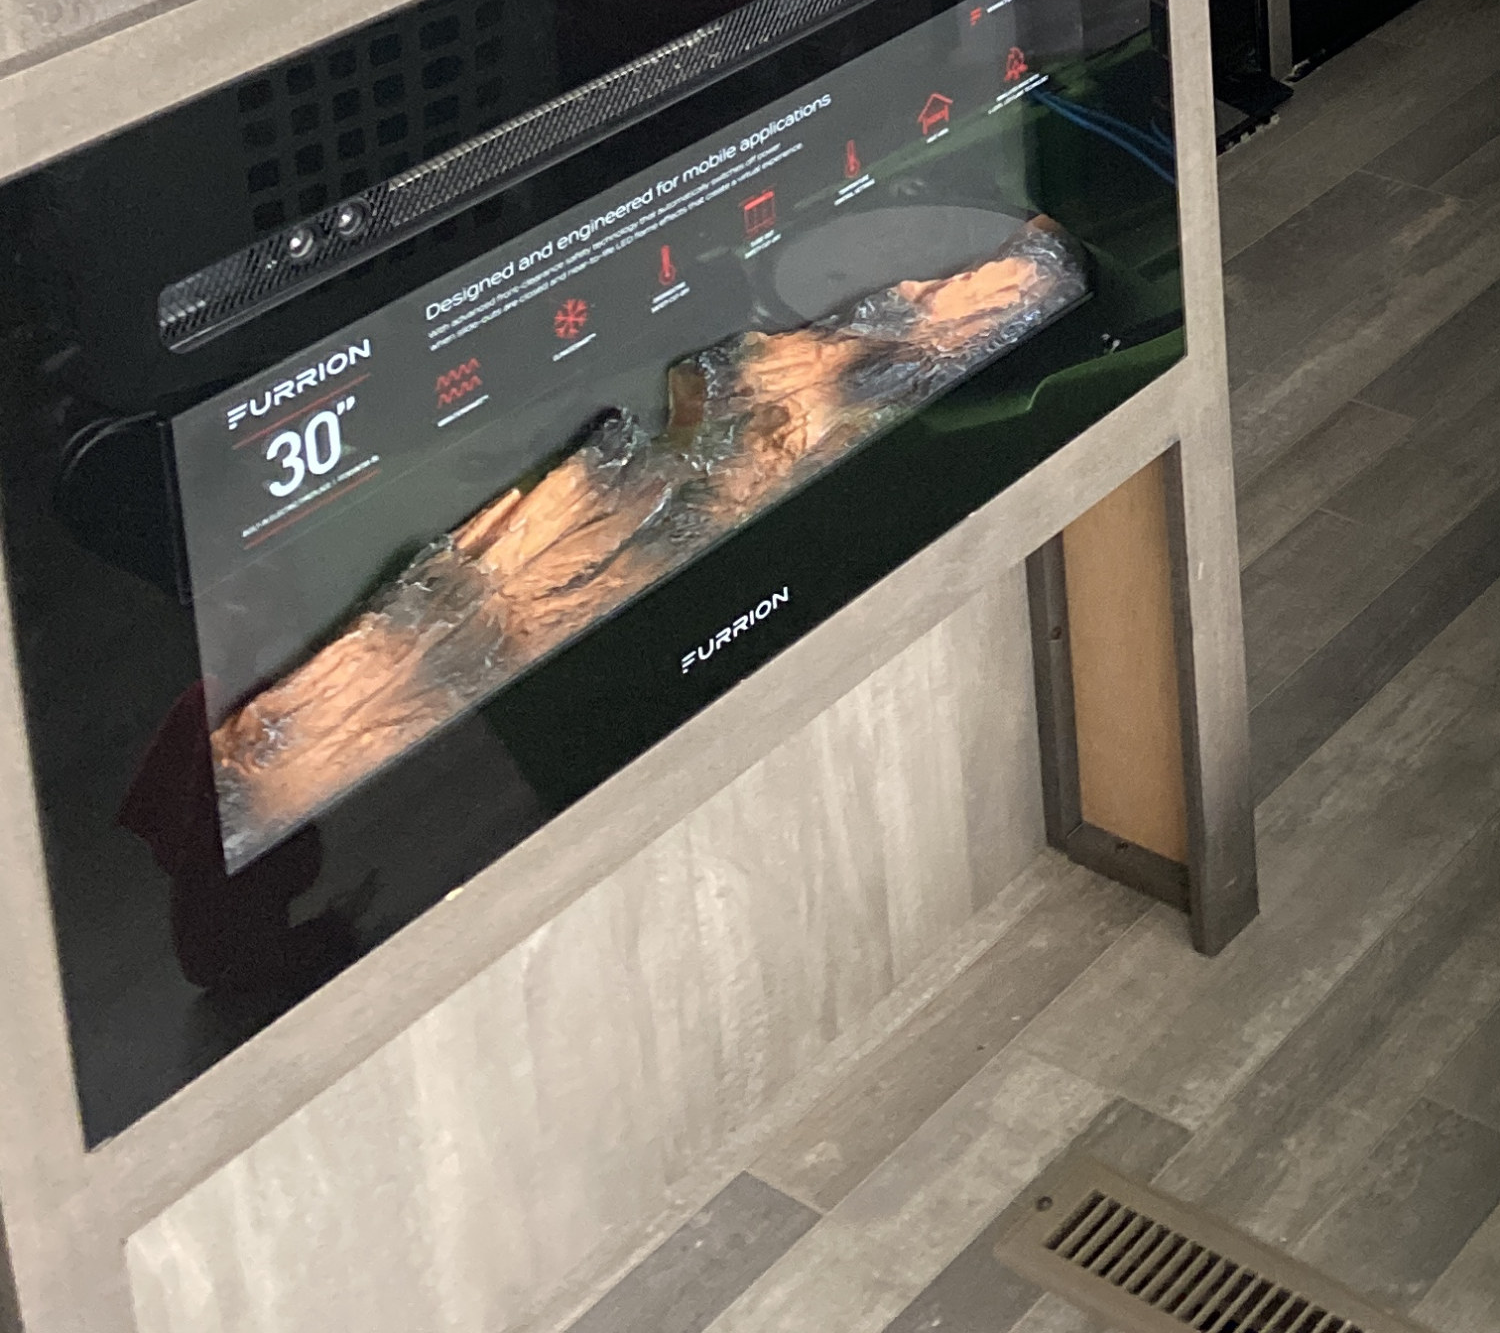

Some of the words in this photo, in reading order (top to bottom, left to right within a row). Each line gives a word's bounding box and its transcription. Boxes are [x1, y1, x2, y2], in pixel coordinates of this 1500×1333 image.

[426, 262, 514, 320] Designed
[519, 242, 552, 270] and
[557, 188, 653, 249] engineered
[656, 176, 679, 196] for
[683, 146, 736, 182] mobile
[740, 94, 831, 151] applications
[616, 236, 634, 250] LED
[227, 339, 371, 430] FURRION
[681, 586, 789, 675] FURRION
